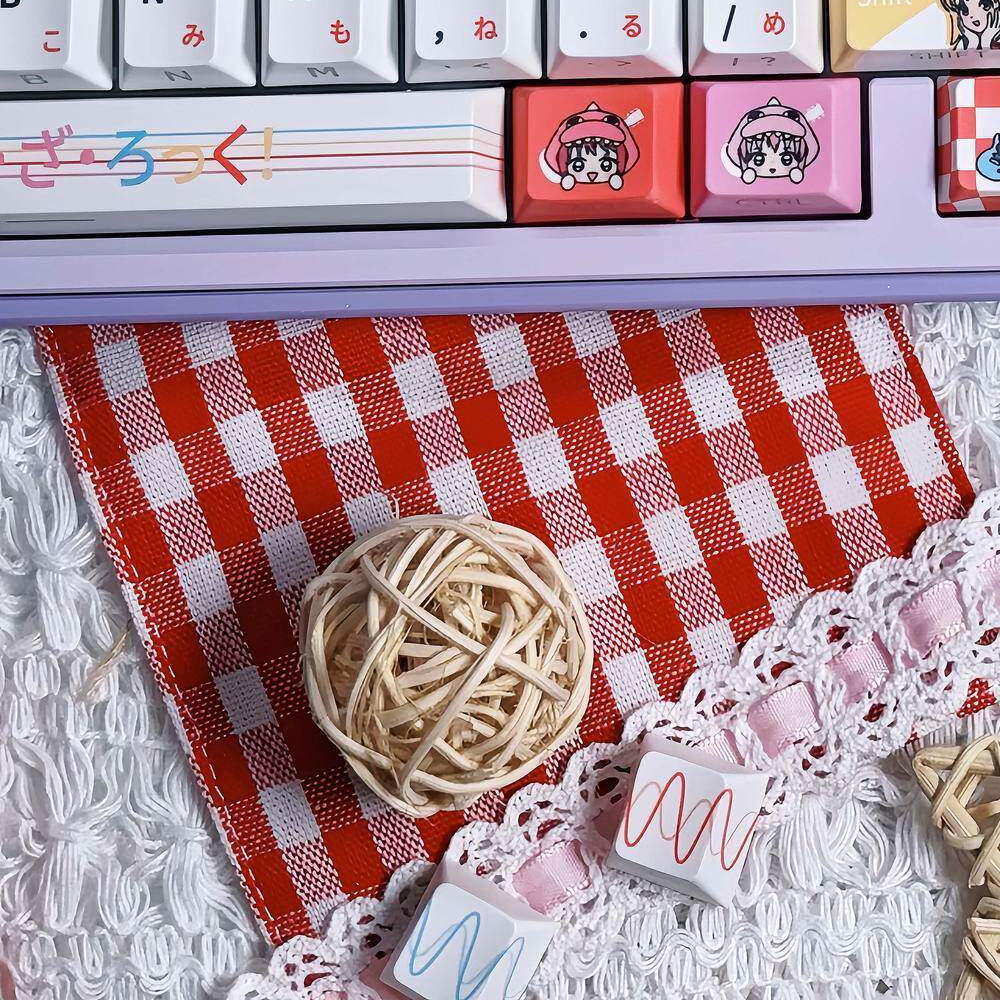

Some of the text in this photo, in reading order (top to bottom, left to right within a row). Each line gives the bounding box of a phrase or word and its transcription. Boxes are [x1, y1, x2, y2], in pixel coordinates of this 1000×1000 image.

[330, 20, 350, 44] も
[474, 17, 497, 40] ね
[764, 12, 785, 35] め
[44, 31, 60, 52] こ
[183, 25, 205, 47] み
